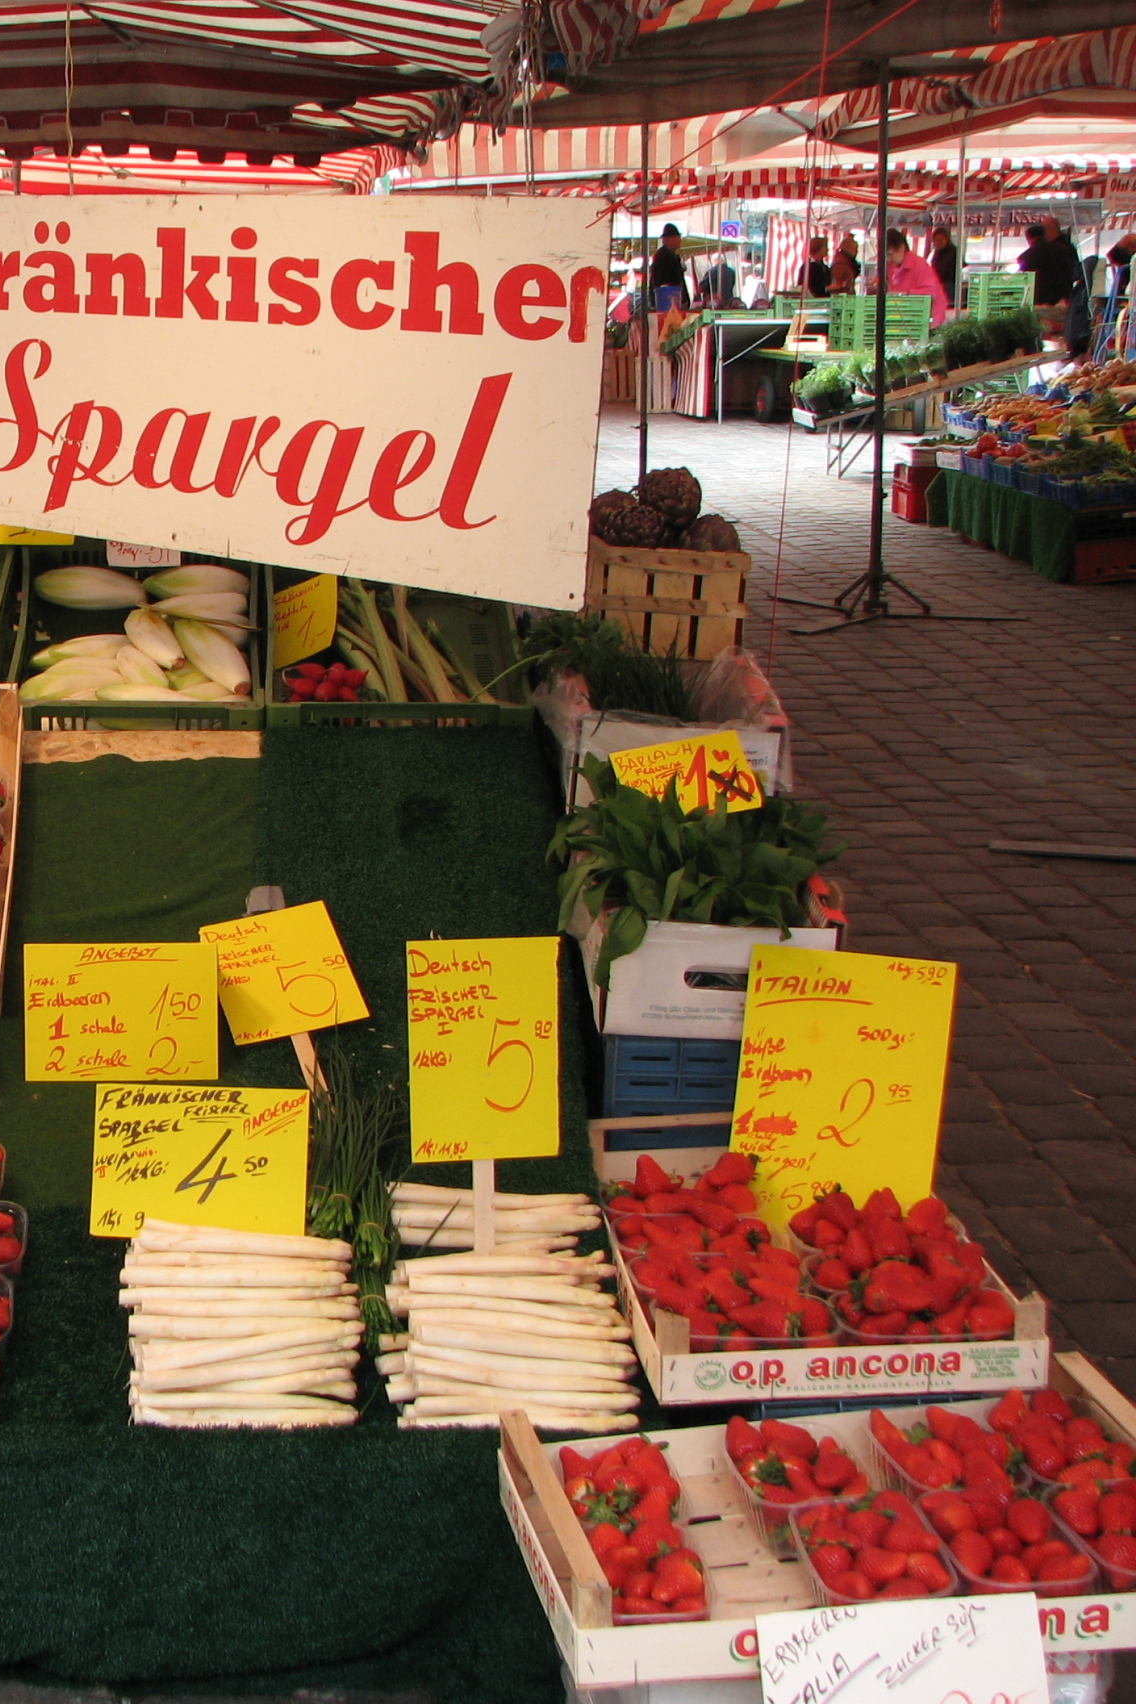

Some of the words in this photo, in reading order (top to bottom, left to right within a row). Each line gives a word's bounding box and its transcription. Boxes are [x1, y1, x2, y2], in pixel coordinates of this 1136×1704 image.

[932, 209, 983, 225] Wrst
[683, 745, 709, 807] 1
[203, 921, 269, 944] Deutsch
[78, 946, 162, 962] ANGEBOT
[408, 949, 493, 978] Deutsch
[276, 961, 338, 1017] 5
[322, 954, 346, 967] 50
[407, 984, 499, 1004] FRISCHER
[27, 991, 112, 1011] Erdbeeren
[410, 1005, 485, 1023] SPARGEL
[48, 1013, 70, 1041] 1
[44, 1045, 67, 1073] 2
[484, 1018, 535, 1113] 5
[98, 1086, 244, 1112] FRÄNKISCHER
[183, 1104, 251, 1118] FRISCHER
[816, 1077, 876, 1148] 2
[886, 1083, 913, 1100] 95
[243, 1092, 309, 1136] ANGEBOT
[98, 1118, 184, 1139] SPARGEL
[174, 1128, 239, 1206] 4
[243, 1156, 269, 1174] 50
[729, 1358, 788, 1388] o.p.
[805, 1350, 963, 1380] ancona
[875, 1627, 944, 1685] ZUCKER
